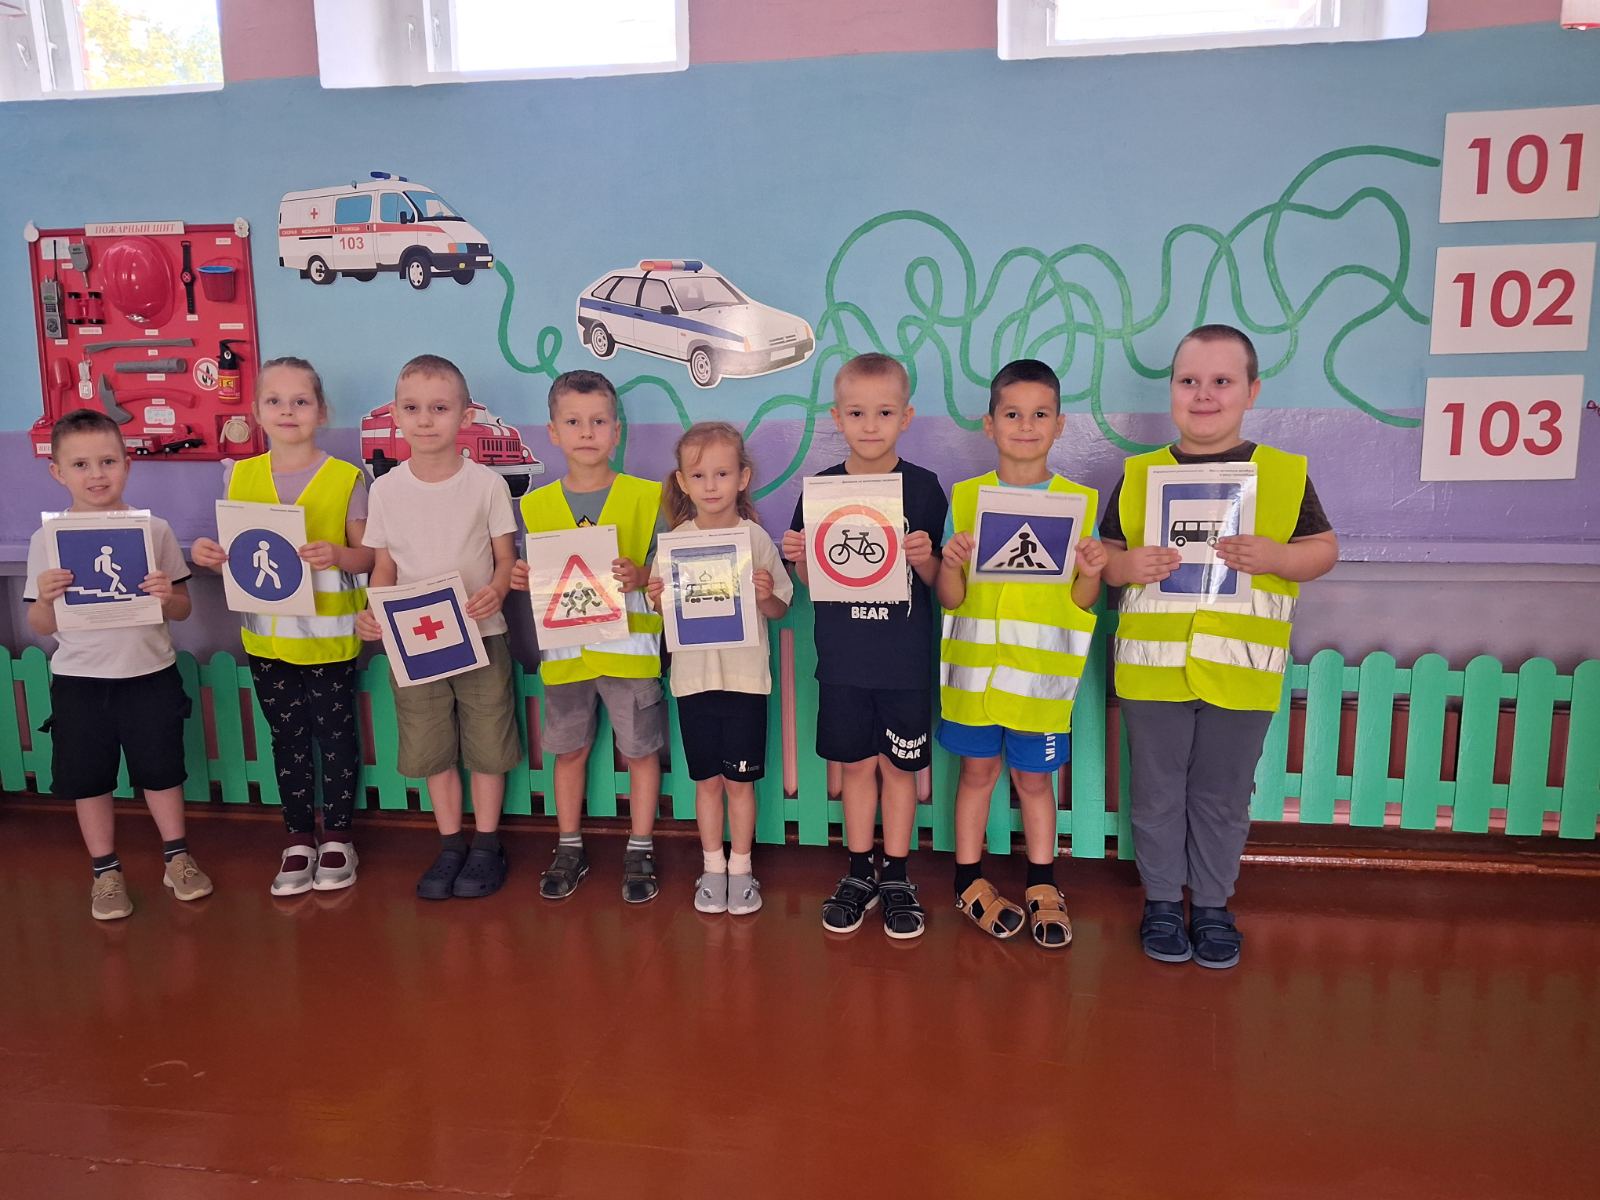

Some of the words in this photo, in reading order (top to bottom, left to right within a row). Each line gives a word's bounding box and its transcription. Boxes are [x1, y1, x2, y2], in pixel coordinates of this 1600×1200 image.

[1468, 133, 1584, 195] 101
[340, 236, 365, 251] 103
[1452, 268, 1575, 328] 102
[1442, 400, 1563, 456] 103
[851, 606, 889, 620] BEAR
[885, 728, 927, 749] RUSSIAN
[891, 744, 921, 759] BEAR
